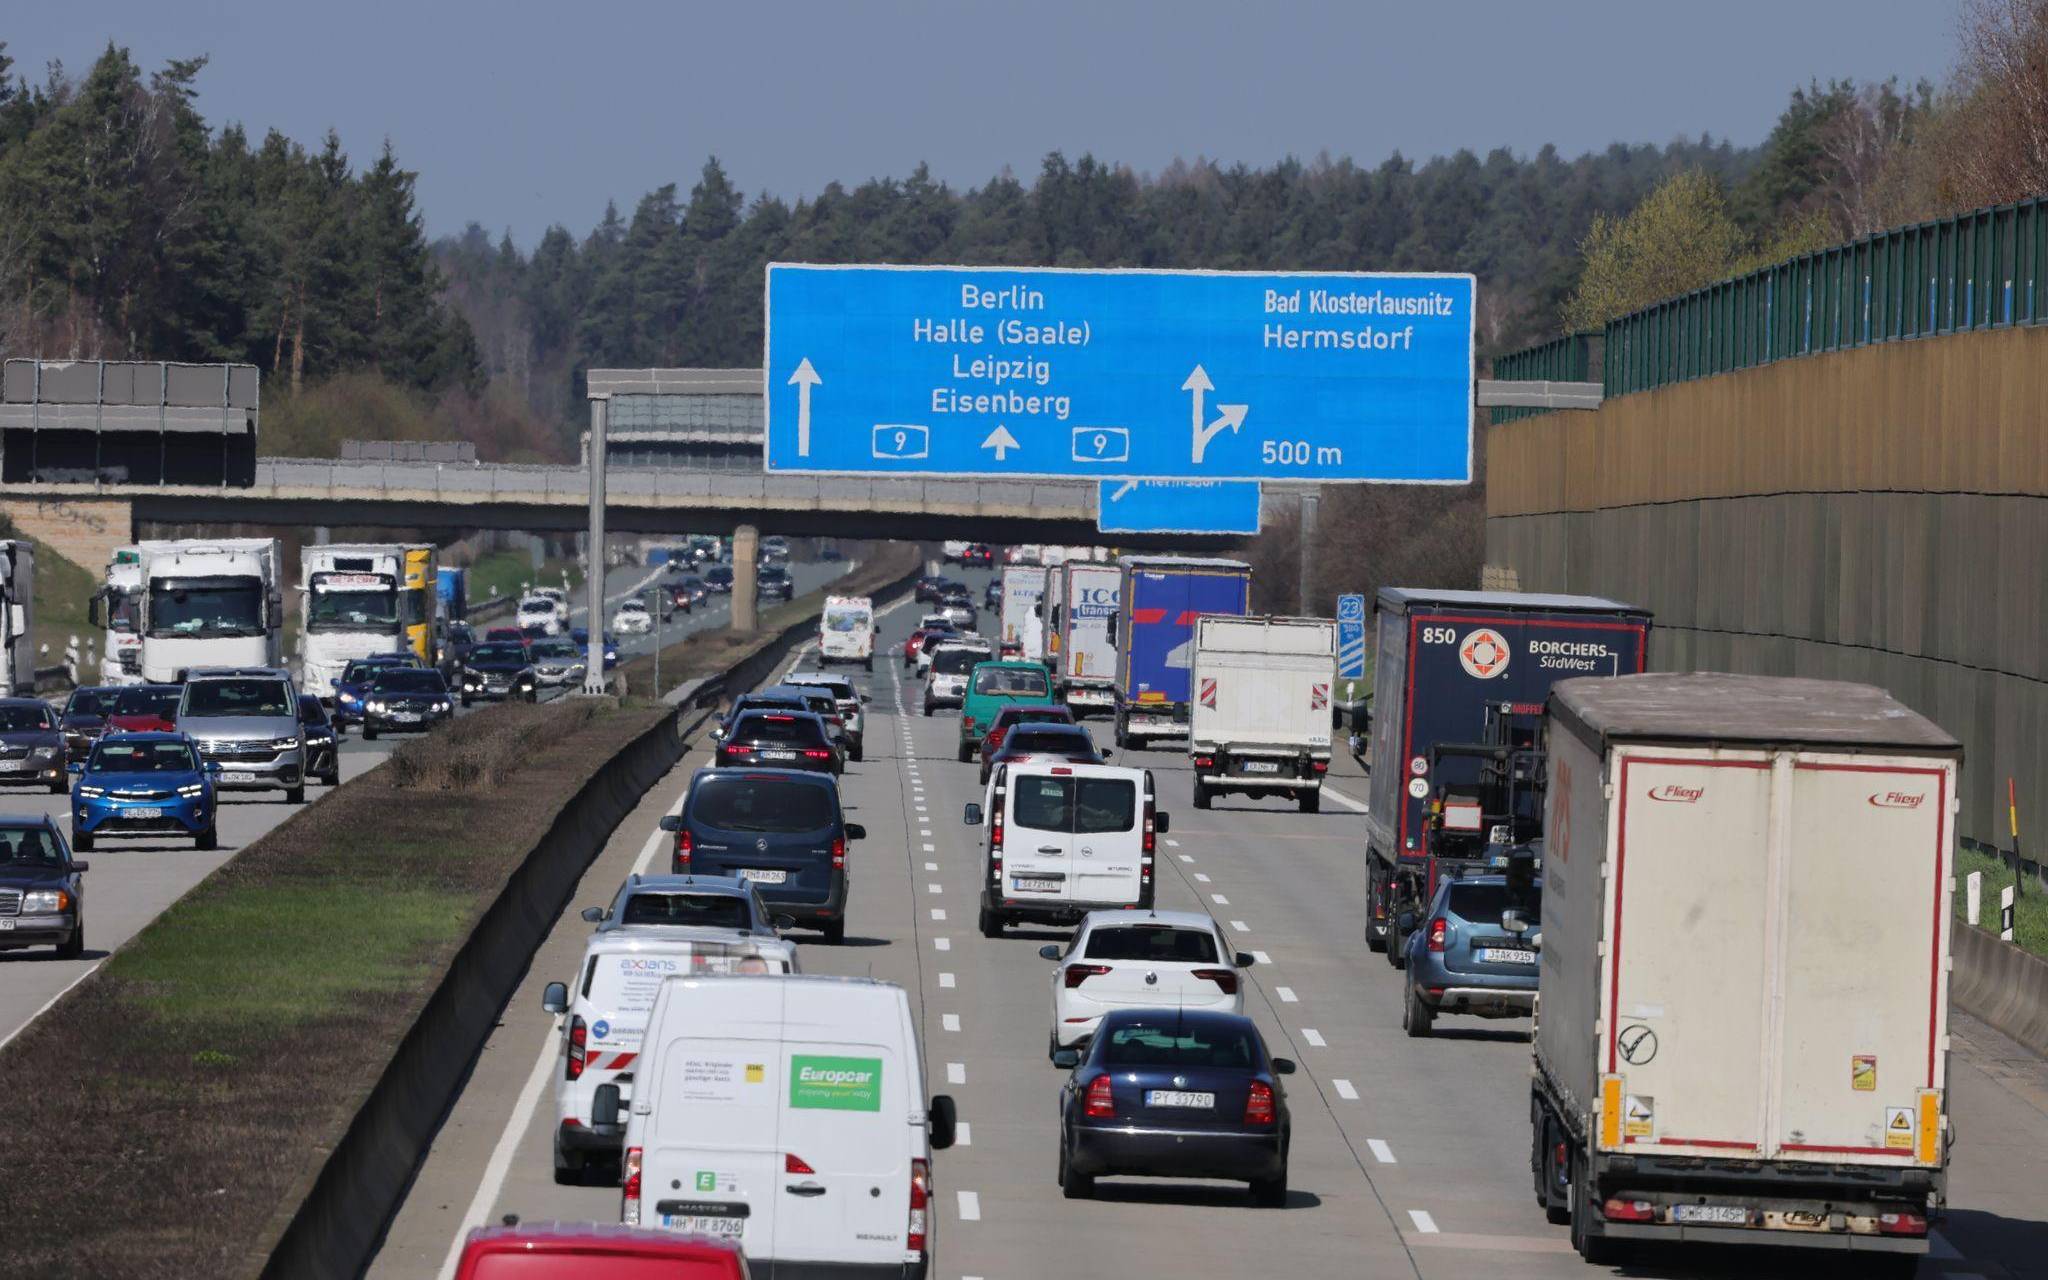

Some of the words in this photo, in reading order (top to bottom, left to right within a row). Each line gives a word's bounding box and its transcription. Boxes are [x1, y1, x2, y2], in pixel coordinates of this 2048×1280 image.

[962, 285, 1044, 309] Berlin
[1264, 289, 1300, 313] Bad
[1309, 290, 1453, 316] Klosterlausnitz
[914, 319, 984, 344] Halle
[998, 319, 1090, 346] (Saale)
[1264, 325, 1413, 350] Hermsdorf
[953, 354, 1050, 384] Leipzig
[932, 388, 1070, 420] Eisenberg
[894, 431, 906, 451] 9
[1094, 434, 1107, 455] 9
[1263, 441, 1310, 465] 500
[1317, 447, 1342, 465] m
[1343, 601, 1359, 614] 23
[1422, 627, 1456, 645] 850
[1529, 640, 1608, 658] BORCHERS
[1539, 655, 1597, 671] SüdWest
[1414, 761, 1425, 770] 80
[1413, 783, 1425, 793] 70
[1664, 785, 1704, 802] Fliegl
[1885, 791, 1926, 807] Fliegl
[2, 919, 13, 930] 97
[620, 959, 677, 971] axians
[799, 1066, 873, 1087] Europcar
[700, 1174, 713, 1187] E
[711, 1218, 742, 1233] 8766
